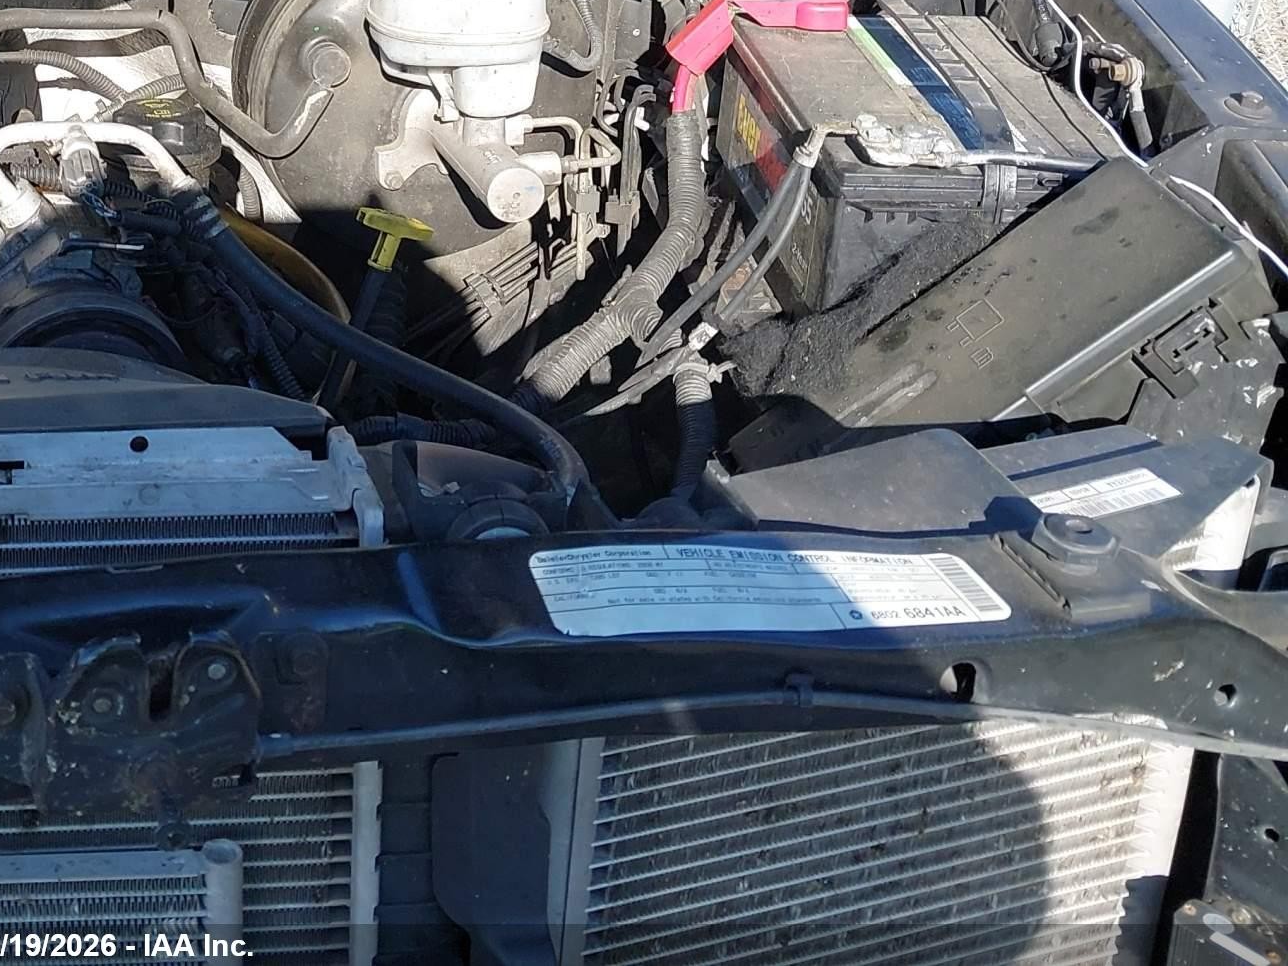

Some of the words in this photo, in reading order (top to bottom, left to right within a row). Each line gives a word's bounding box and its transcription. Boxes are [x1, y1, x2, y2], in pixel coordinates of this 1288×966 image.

[605, 549, 652, 561] Corporation
[677, 548, 724, 558] VEHICLE
[729, 549, 784, 561] EMISSION
[787, 553, 836, 563] CONTROL
[840, 554, 913, 565] INFORMATION
[871, 609, 901, 620] 6802
[903, 605, 966, 619] 6841AA
